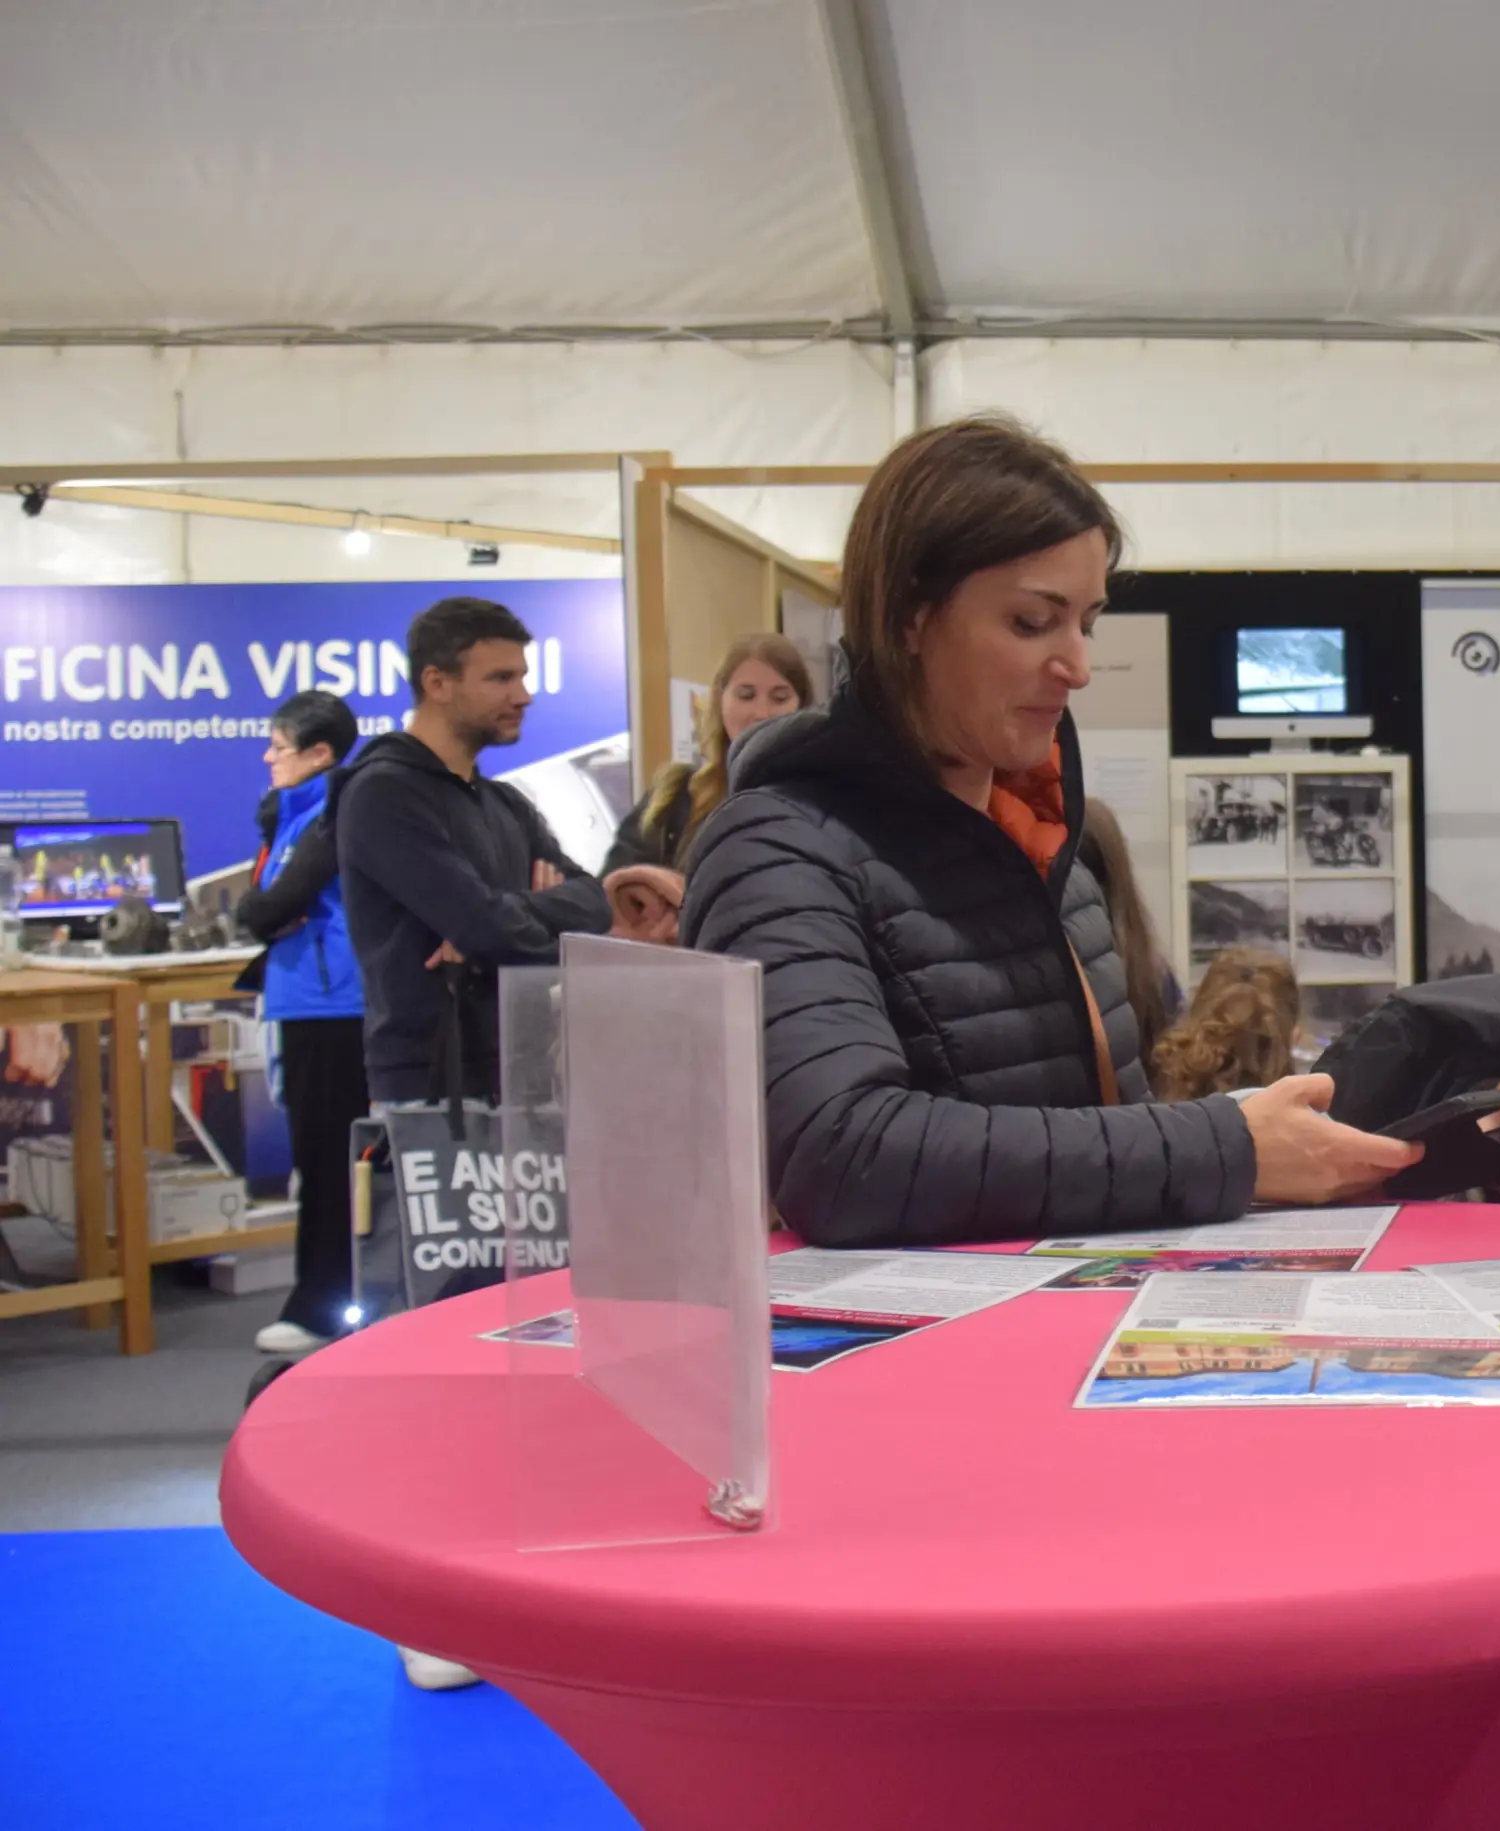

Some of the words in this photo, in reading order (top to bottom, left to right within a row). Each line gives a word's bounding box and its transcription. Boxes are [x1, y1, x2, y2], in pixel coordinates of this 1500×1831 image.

[4, 716, 101, 742] nostra
[109, 714, 274, 744] competenz
[356, 715, 397, 737] ua
[401, 1151, 440, 1193] E
[451, 1150, 567, 1193] ANCH
[407, 1193, 460, 1236] IL
[468, 1191, 557, 1232] SUO
